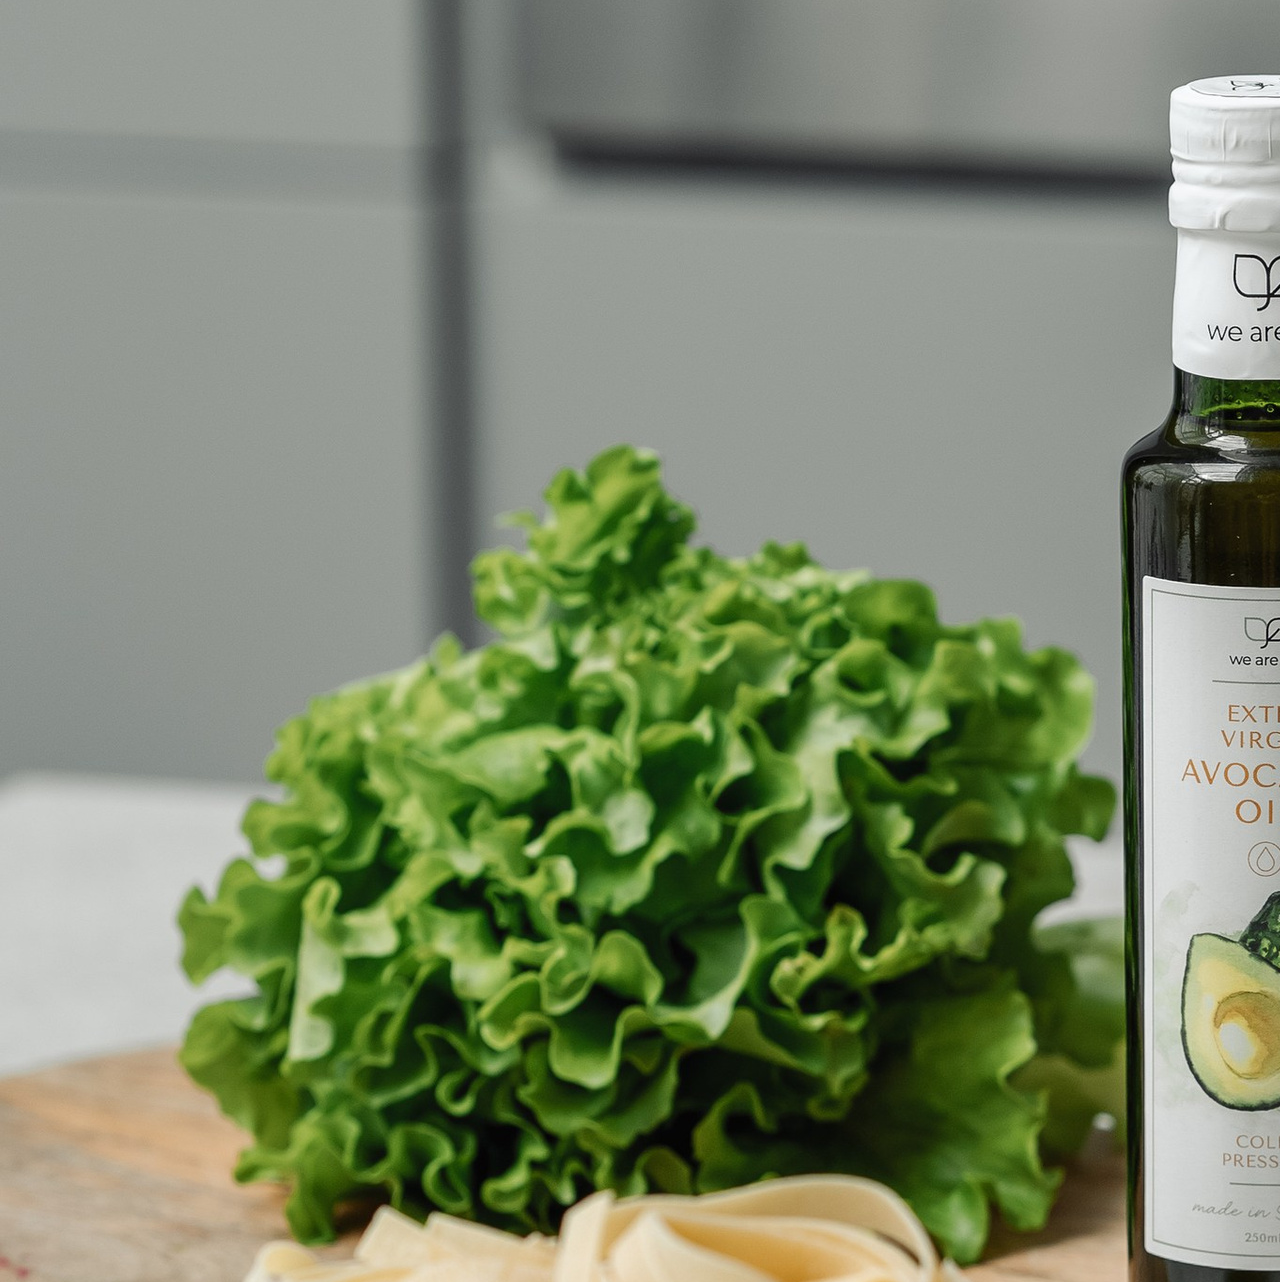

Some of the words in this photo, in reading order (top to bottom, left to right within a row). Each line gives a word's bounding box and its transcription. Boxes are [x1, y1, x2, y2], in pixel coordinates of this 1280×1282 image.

[1207, 324, 1243, 342] we
[1229, 655, 1251, 666] we
[1255, 656, 1278, 666] are
[1192, 1201, 1243, 1217] made
[1248, 1206, 1270, 1218] in
